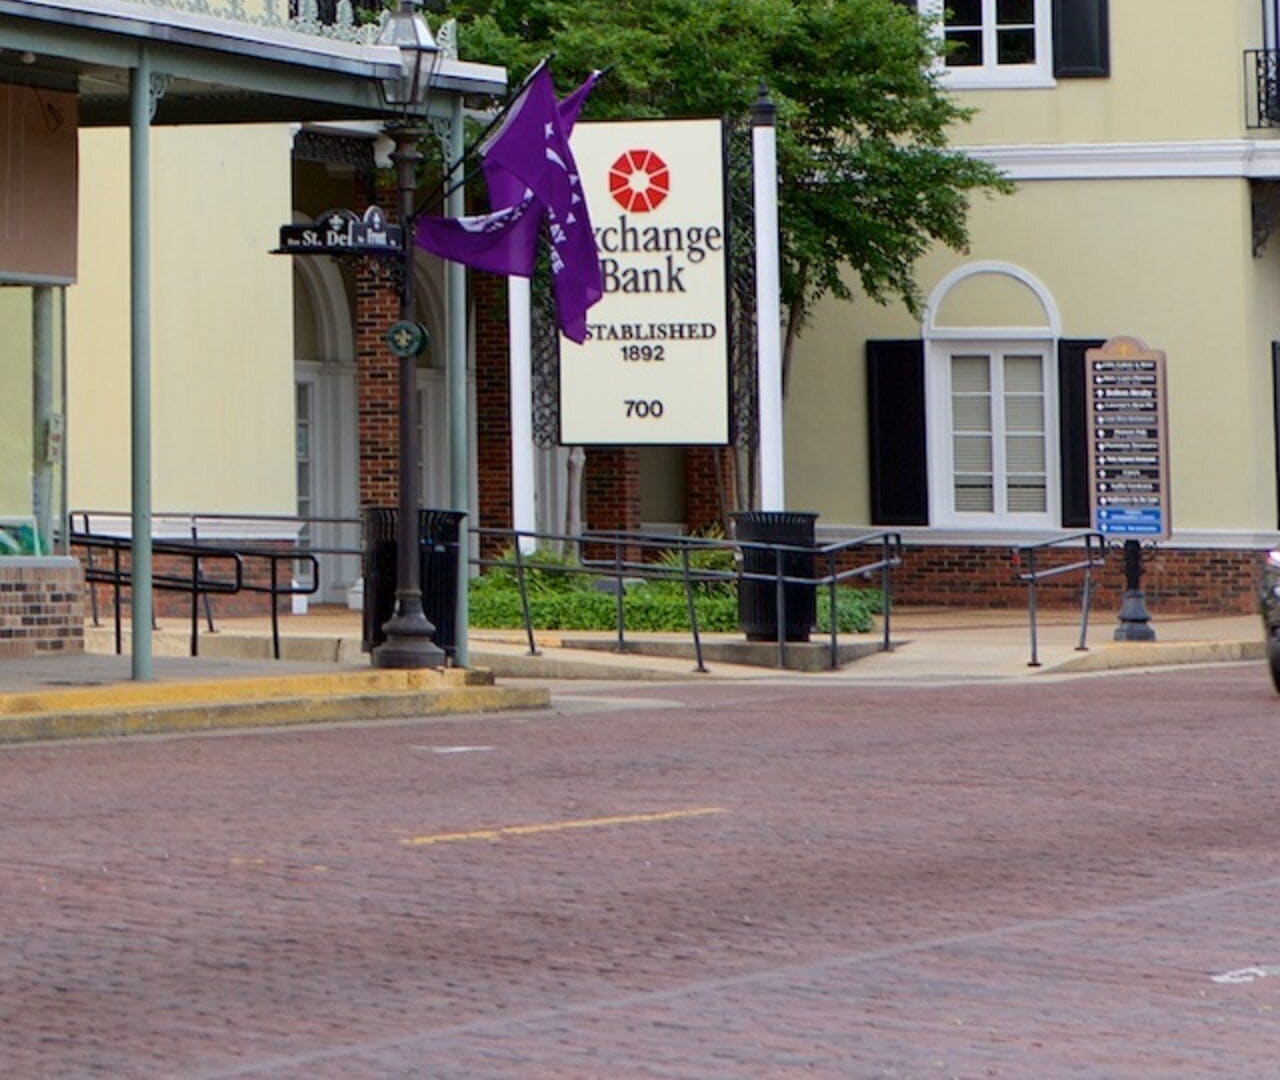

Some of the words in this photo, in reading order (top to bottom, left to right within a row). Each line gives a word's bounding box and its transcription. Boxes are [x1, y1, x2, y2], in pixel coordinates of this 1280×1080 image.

[302, 229, 322, 246] St.
[594, 214, 722, 264] change
[600, 255, 687, 294] Bank
[586, 323, 717, 341] STABLISHED
[621, 345, 665, 361] 1892
[623, 399, 664, 418] 700
